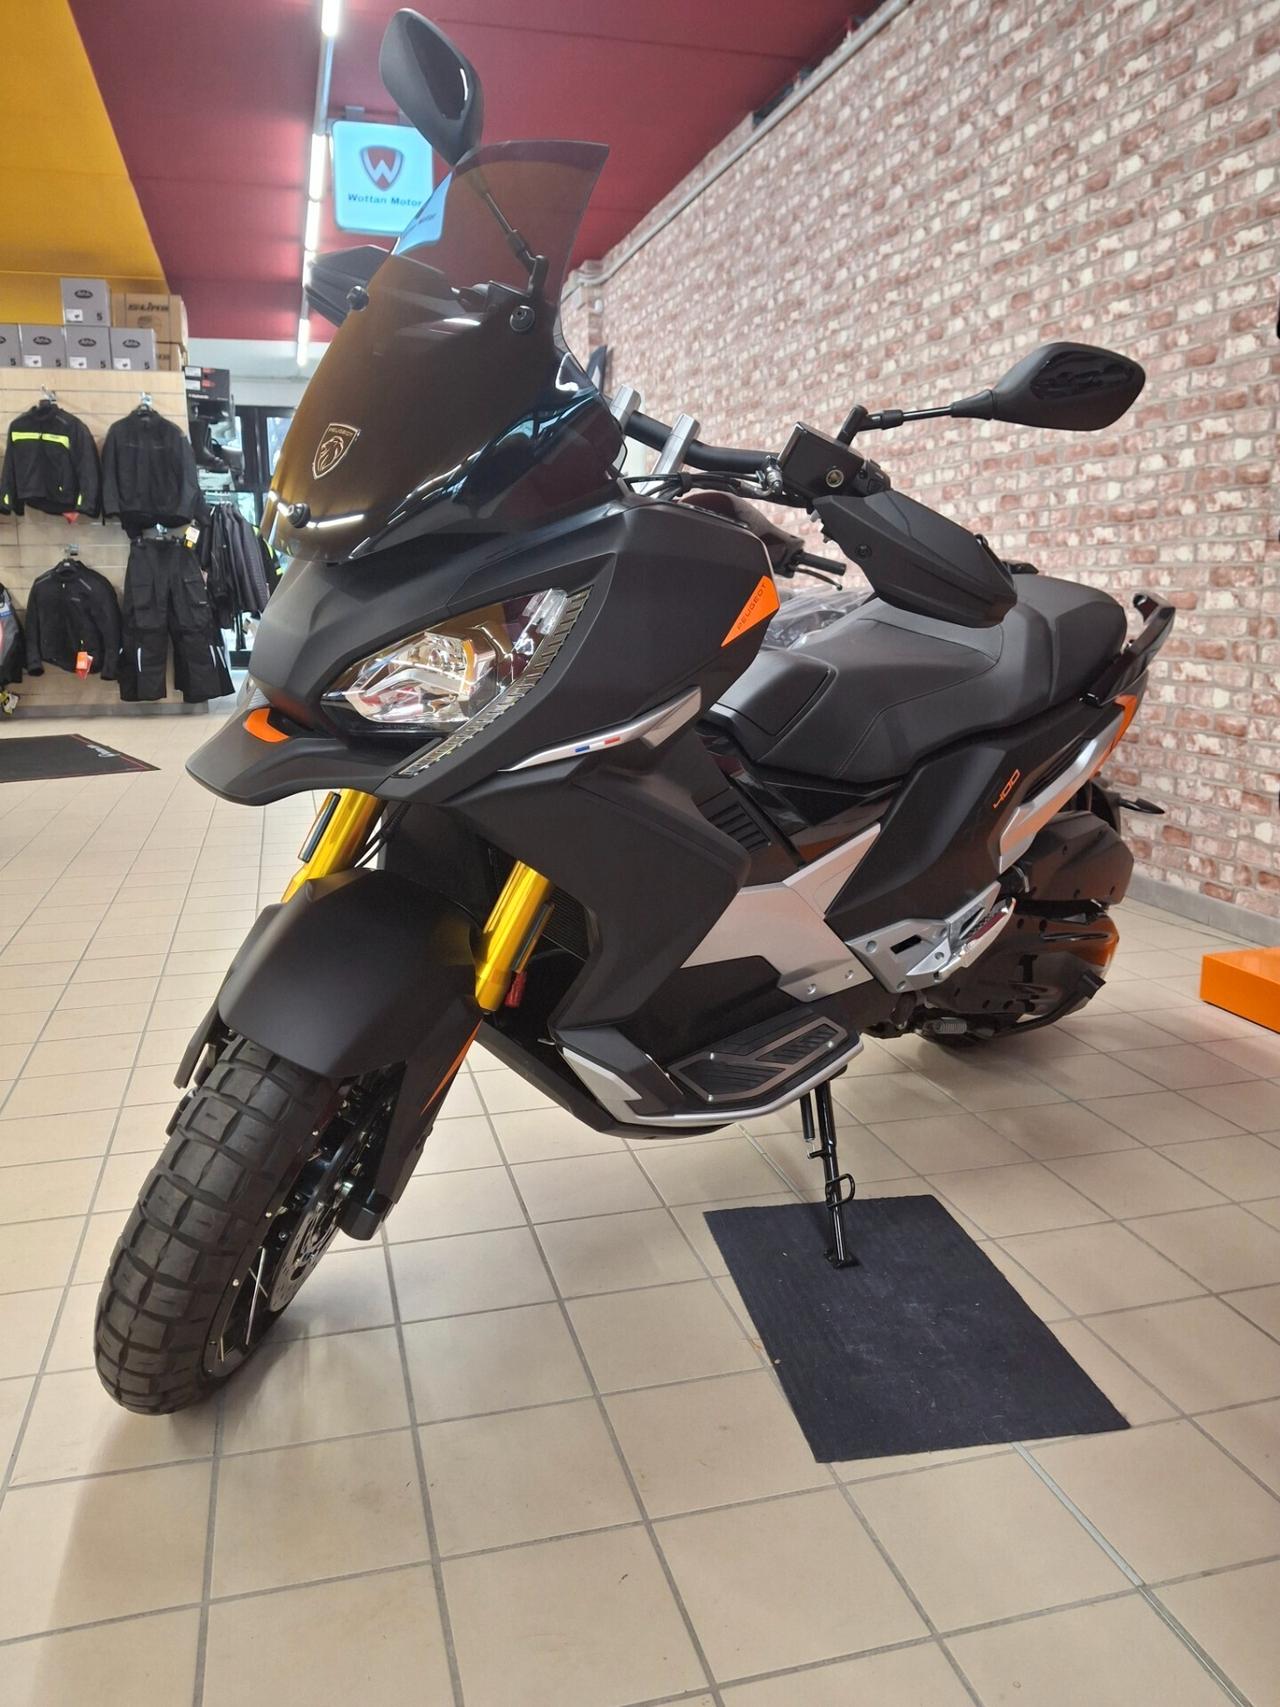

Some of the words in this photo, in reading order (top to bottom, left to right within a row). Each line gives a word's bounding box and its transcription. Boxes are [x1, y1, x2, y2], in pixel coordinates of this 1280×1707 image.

[347, 193, 387, 204] Wottan
[737, 584, 767, 630] PEUGEOT
[992, 768, 1021, 808] 400
